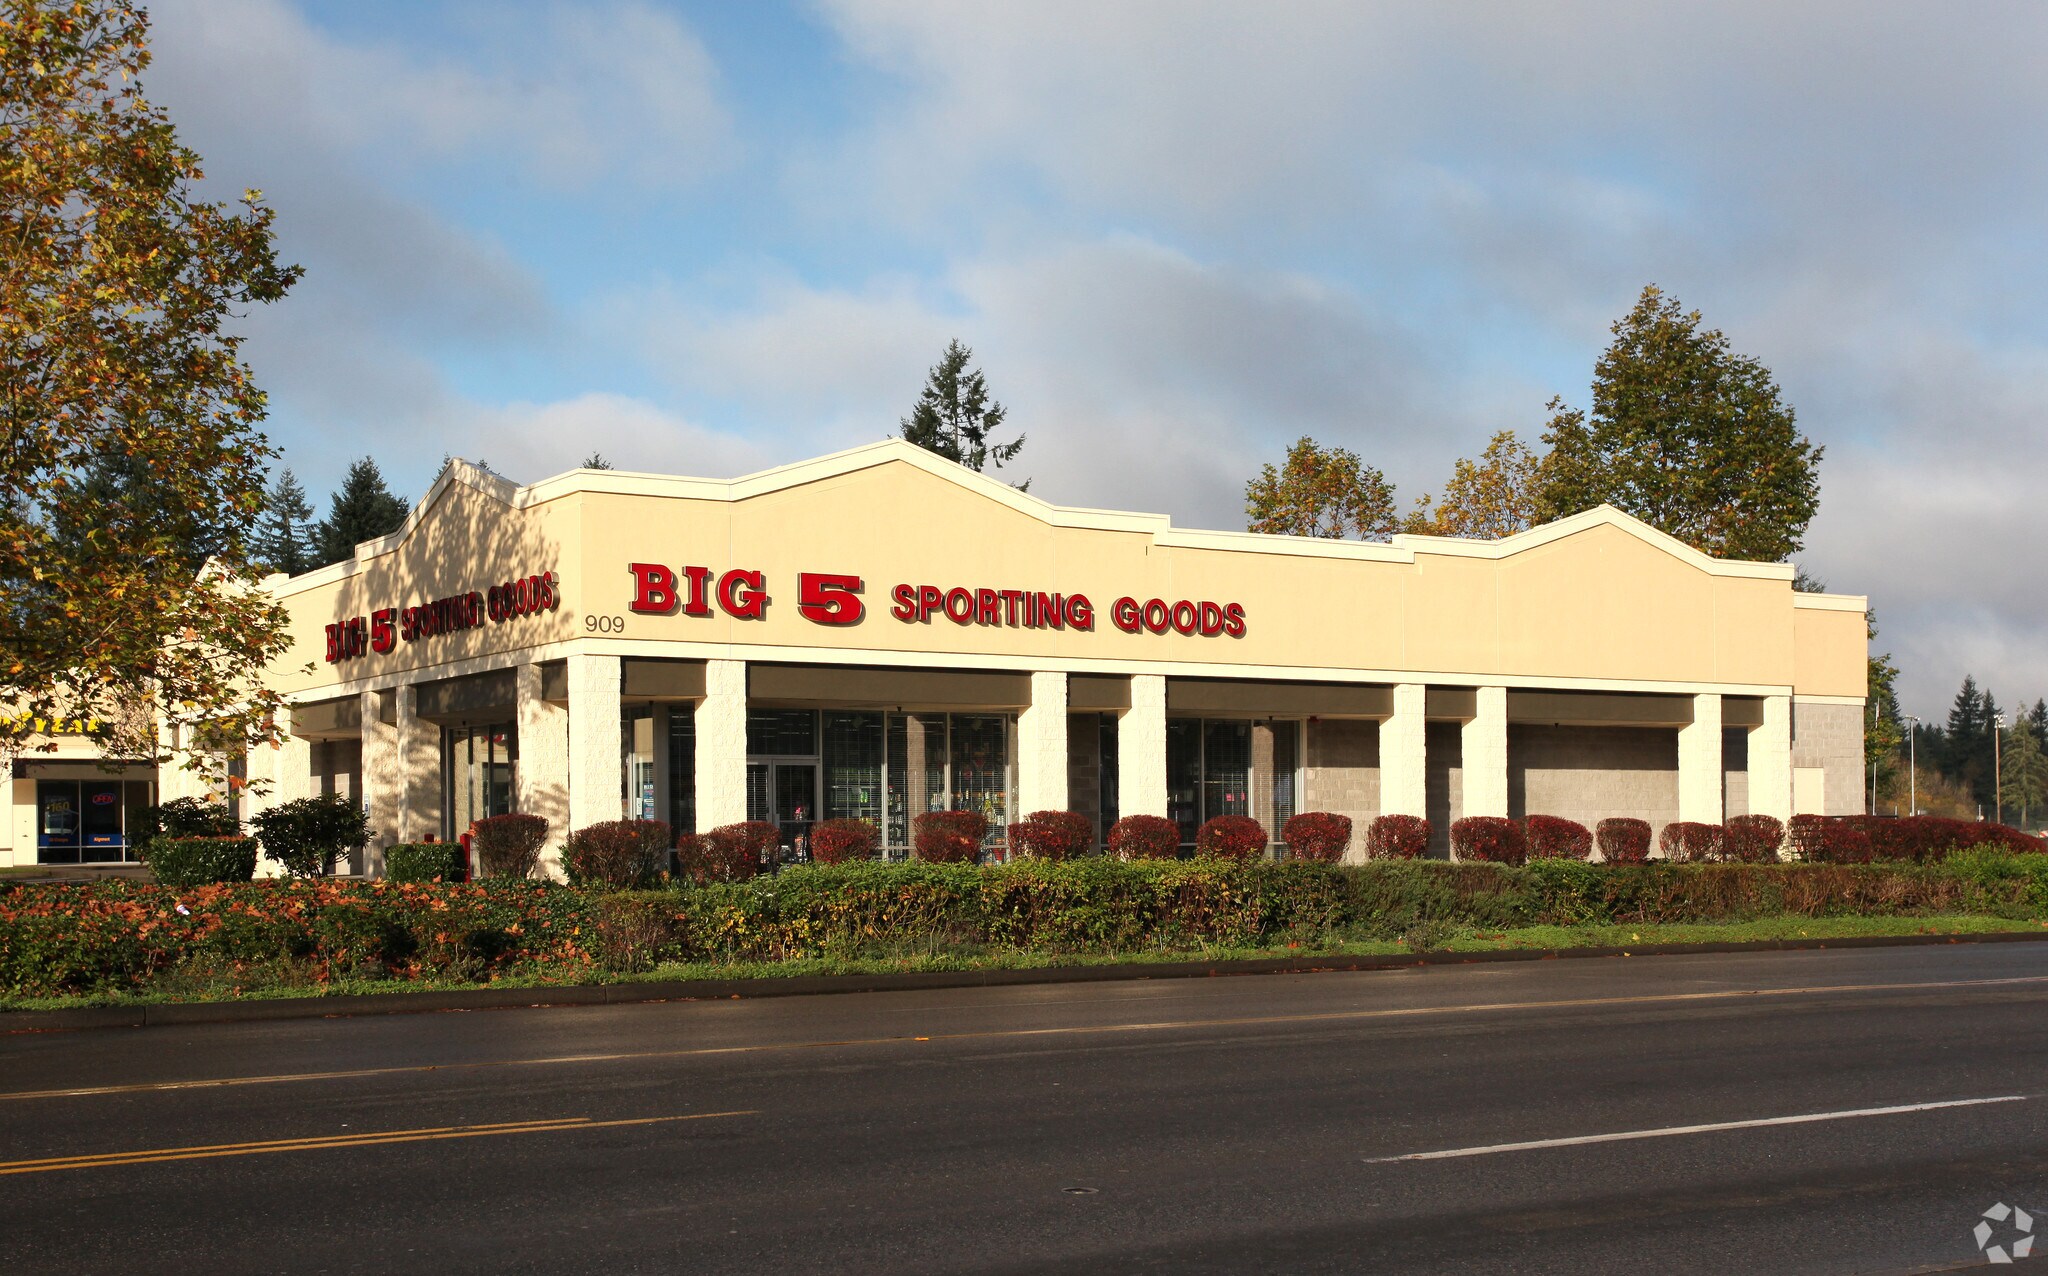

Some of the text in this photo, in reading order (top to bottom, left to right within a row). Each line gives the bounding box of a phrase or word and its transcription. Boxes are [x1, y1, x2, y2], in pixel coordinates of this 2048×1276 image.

[325, 571, 560, 664] BIG 5 SPORTING GOODS
[585, 614, 625, 634] 909
[628, 562, 1246, 638] BIG 5 SPORTING GOODS
